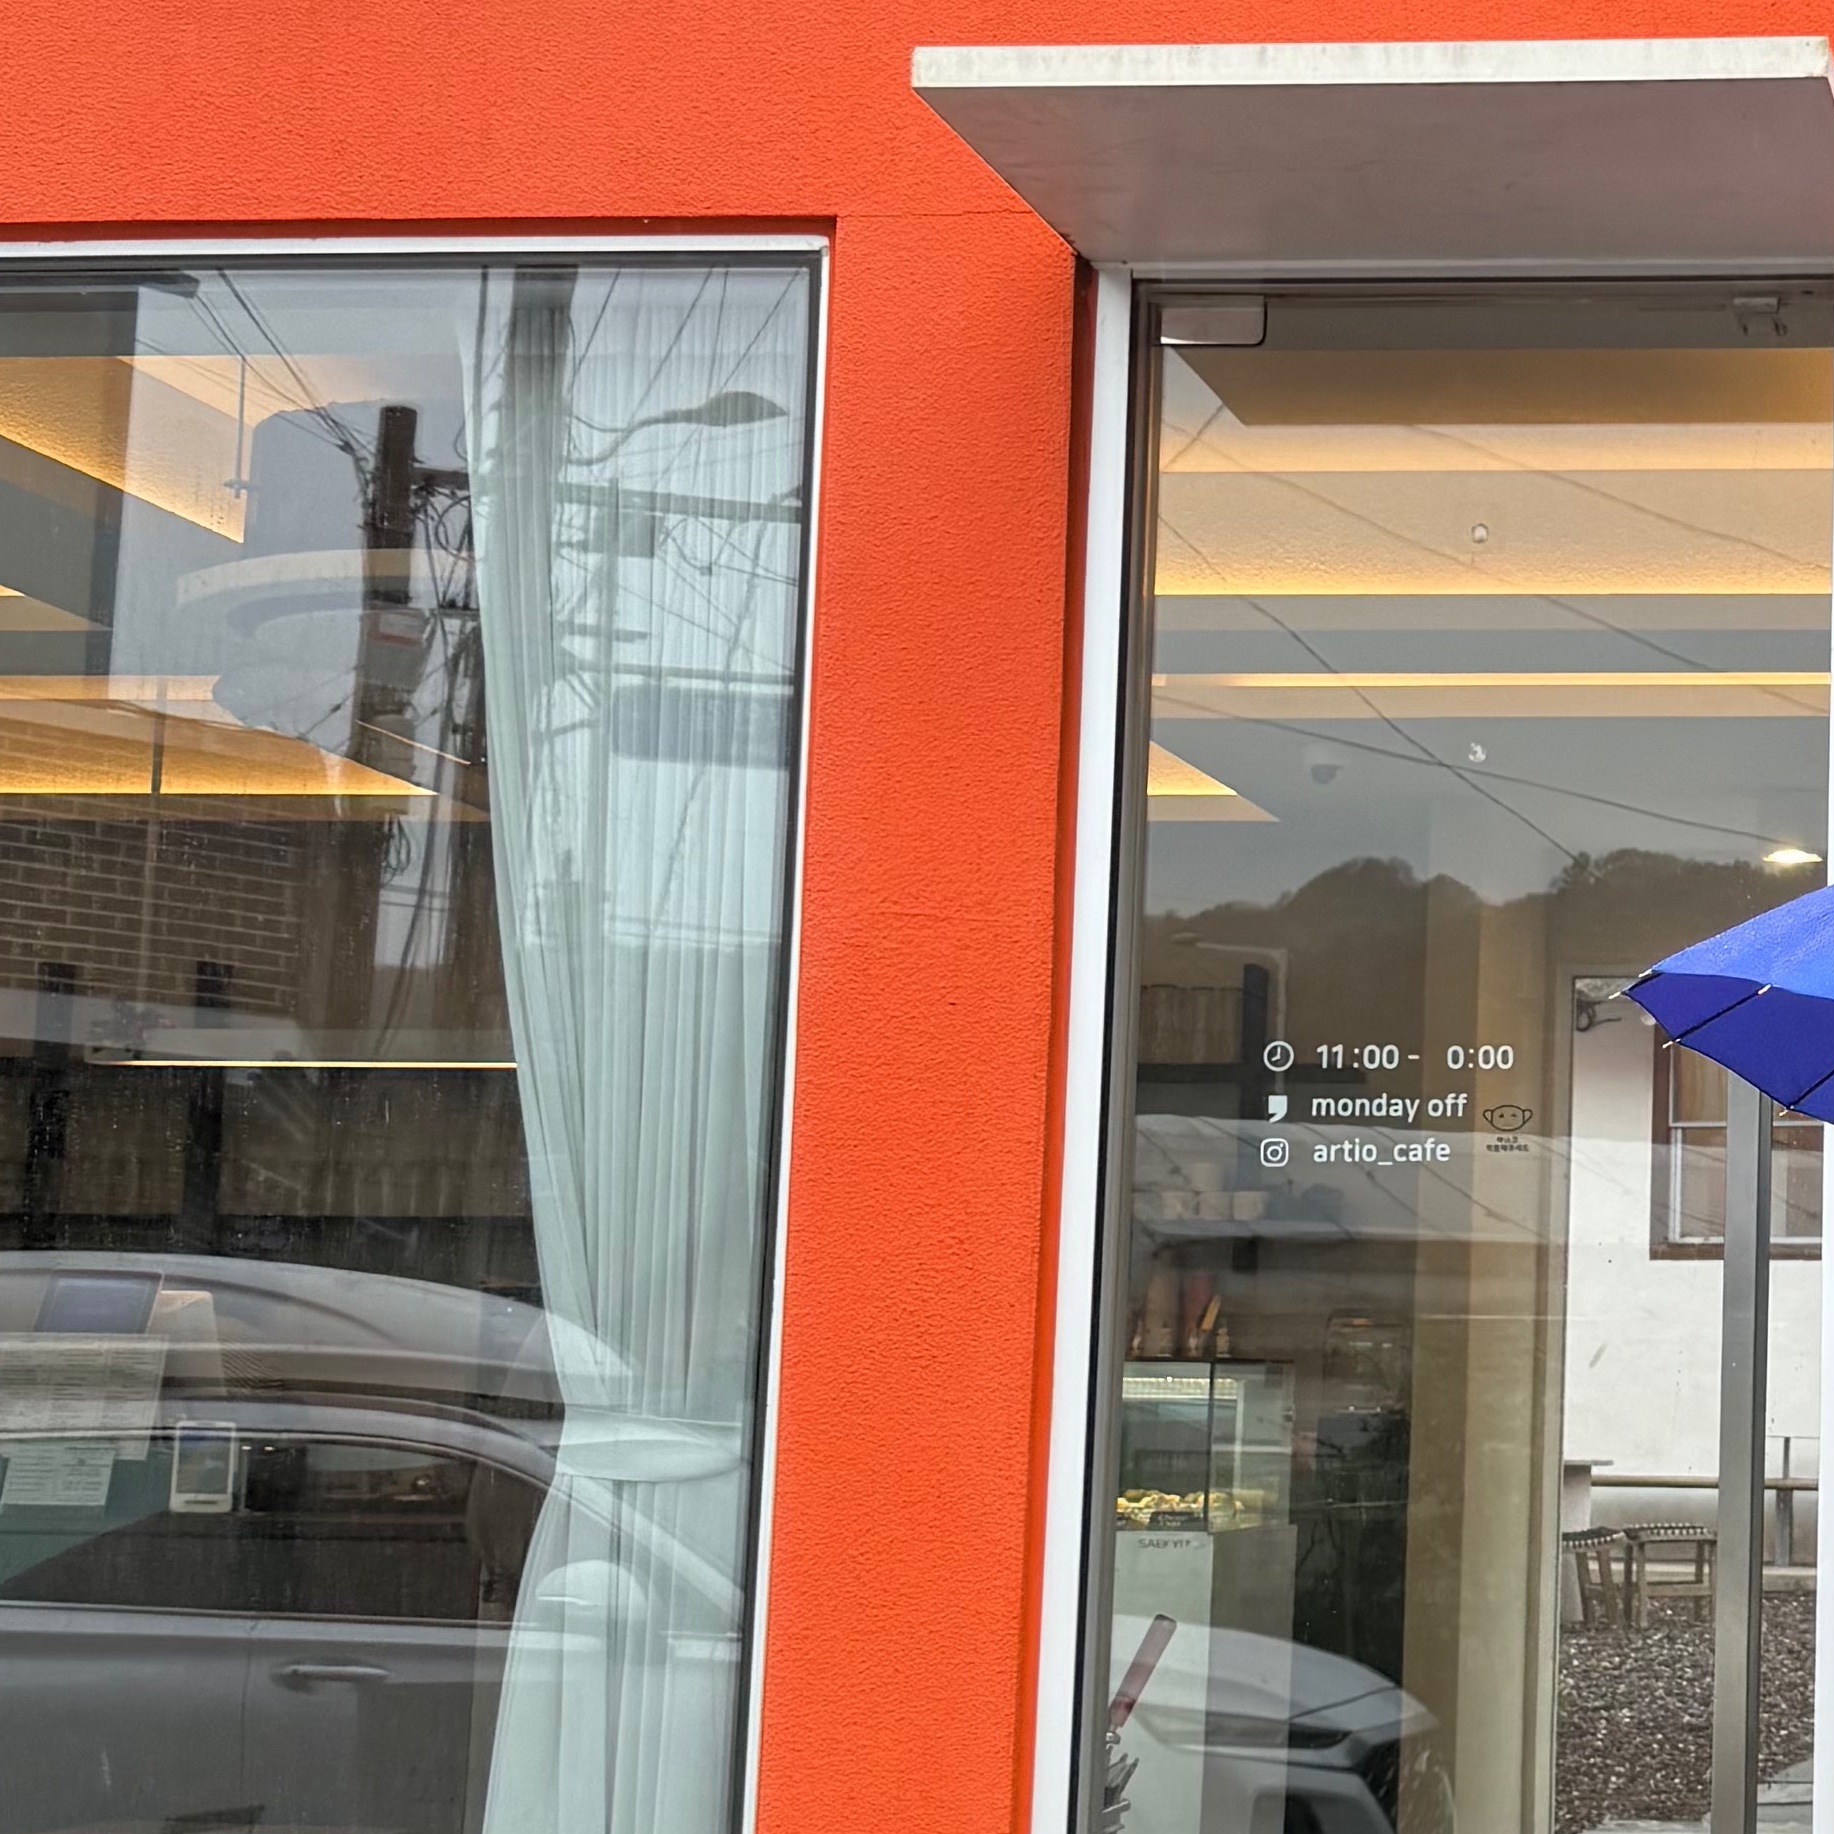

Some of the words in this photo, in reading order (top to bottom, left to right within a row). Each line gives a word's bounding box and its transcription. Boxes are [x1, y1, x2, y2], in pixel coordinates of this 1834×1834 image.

[1311, 1092, 1420, 1123] monday
[1427, 1092, 1468, 1117] off
[1312, 1137, 1451, 1166] artio_cafe
